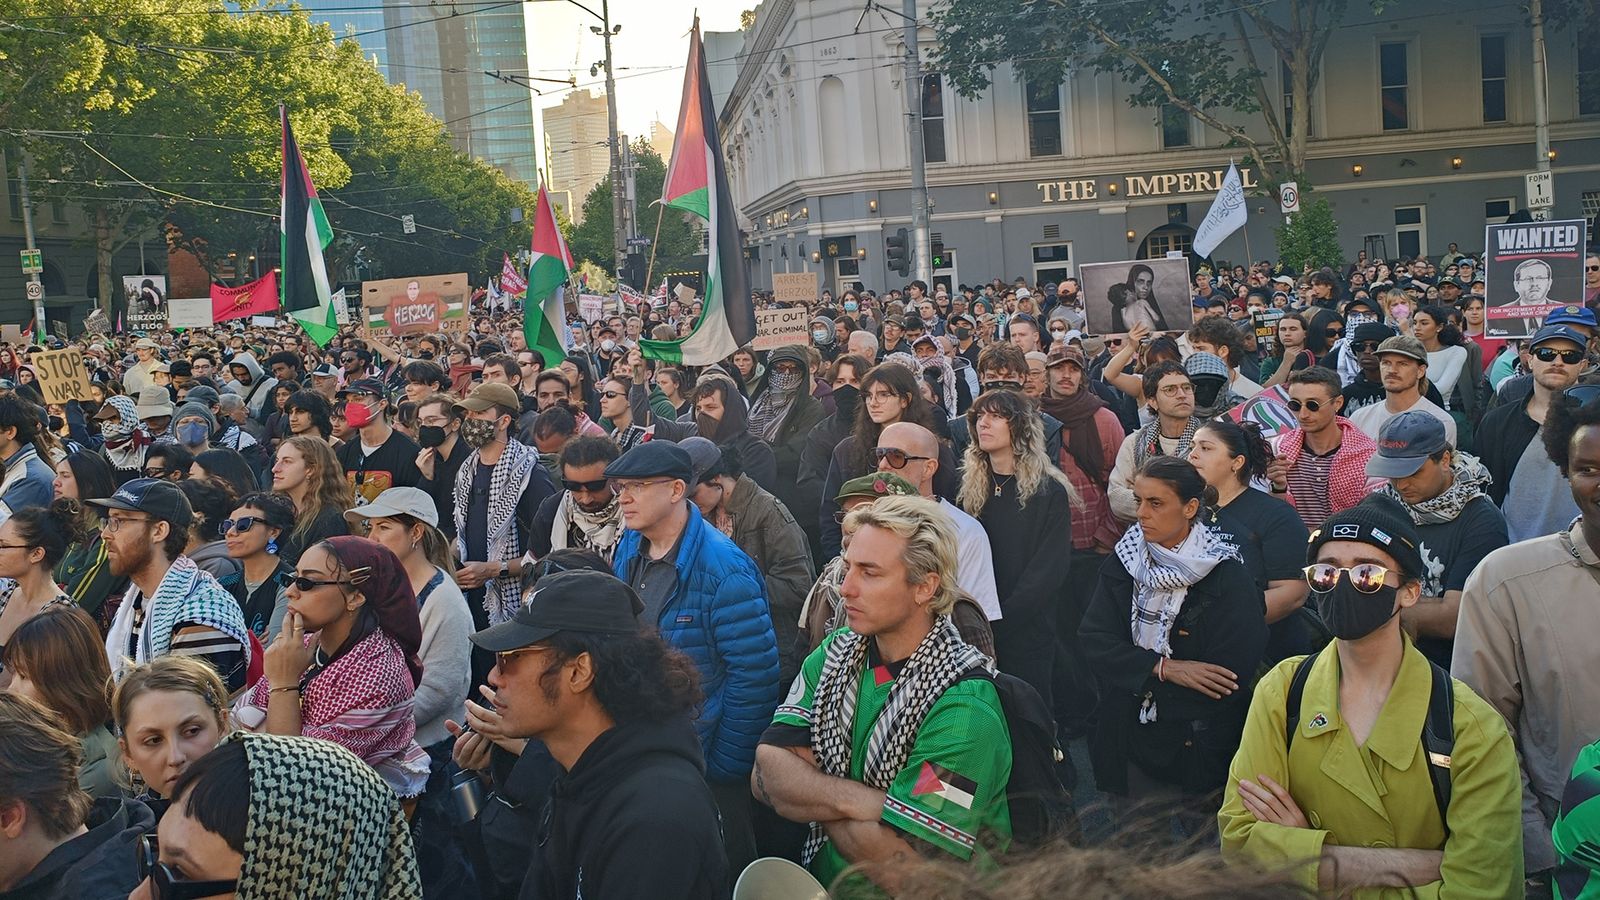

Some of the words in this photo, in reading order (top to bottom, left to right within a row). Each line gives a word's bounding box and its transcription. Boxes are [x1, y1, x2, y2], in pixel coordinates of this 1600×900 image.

[1529, 174, 1549, 182] FORM
[1037, 180, 1097, 203] THE
[1125, 169, 1258, 197] IMPERIL
[1537, 184, 1541, 195] 1
[1284, 192, 1295, 203] 40
[1530, 197, 1550, 205] LANE
[1497, 225, 1579, 250] WANTED
[777, 274, 815, 285] ARREST
[777, 287, 815, 298] HERZOG
[127, 311, 169, 321] HERZOG'S
[394, 303, 435, 325] HERZOG
[756, 313, 778, 327] GET
[782, 311, 806, 323] OUT
[140, 322, 164, 330] FLOG
[369, 328, 389, 337] FUCK
[443, 320, 462, 329] OFF
[772, 324, 808, 335] CRIMINAL
[36, 352, 81, 381] STOP
[48, 380, 85, 401] WAR
